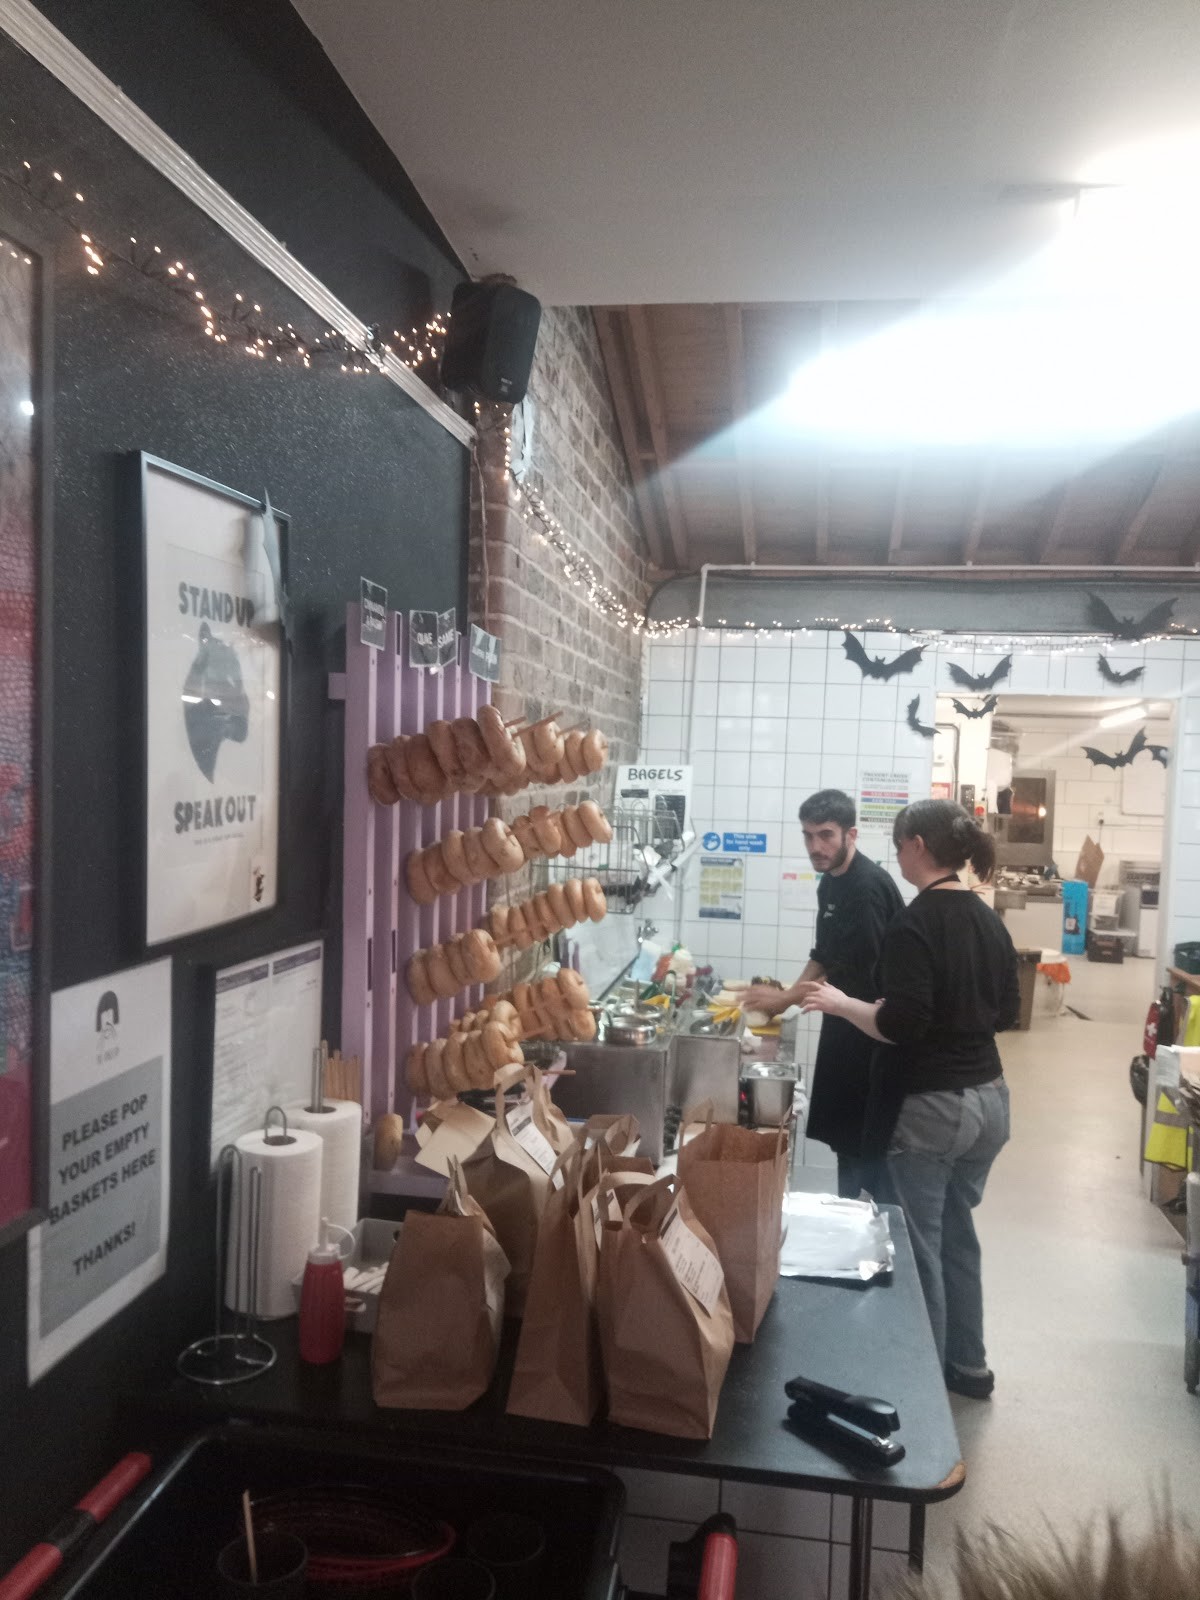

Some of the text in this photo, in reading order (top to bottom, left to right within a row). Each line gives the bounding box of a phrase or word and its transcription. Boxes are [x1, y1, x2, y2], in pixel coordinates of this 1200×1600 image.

[179, 581, 255, 628] STAND UP
[628, 768, 684, 781] BAGELS
[174, 795, 256, 835] SPEAK OUT
[62, 1093, 148, 1151] PLEASE POP
[58, 1121, 150, 1184] YOUR EMPTY
[50, 1149, 156, 1225] BASKETS HERE
[72, 1221, 136, 1276] THANKS!
